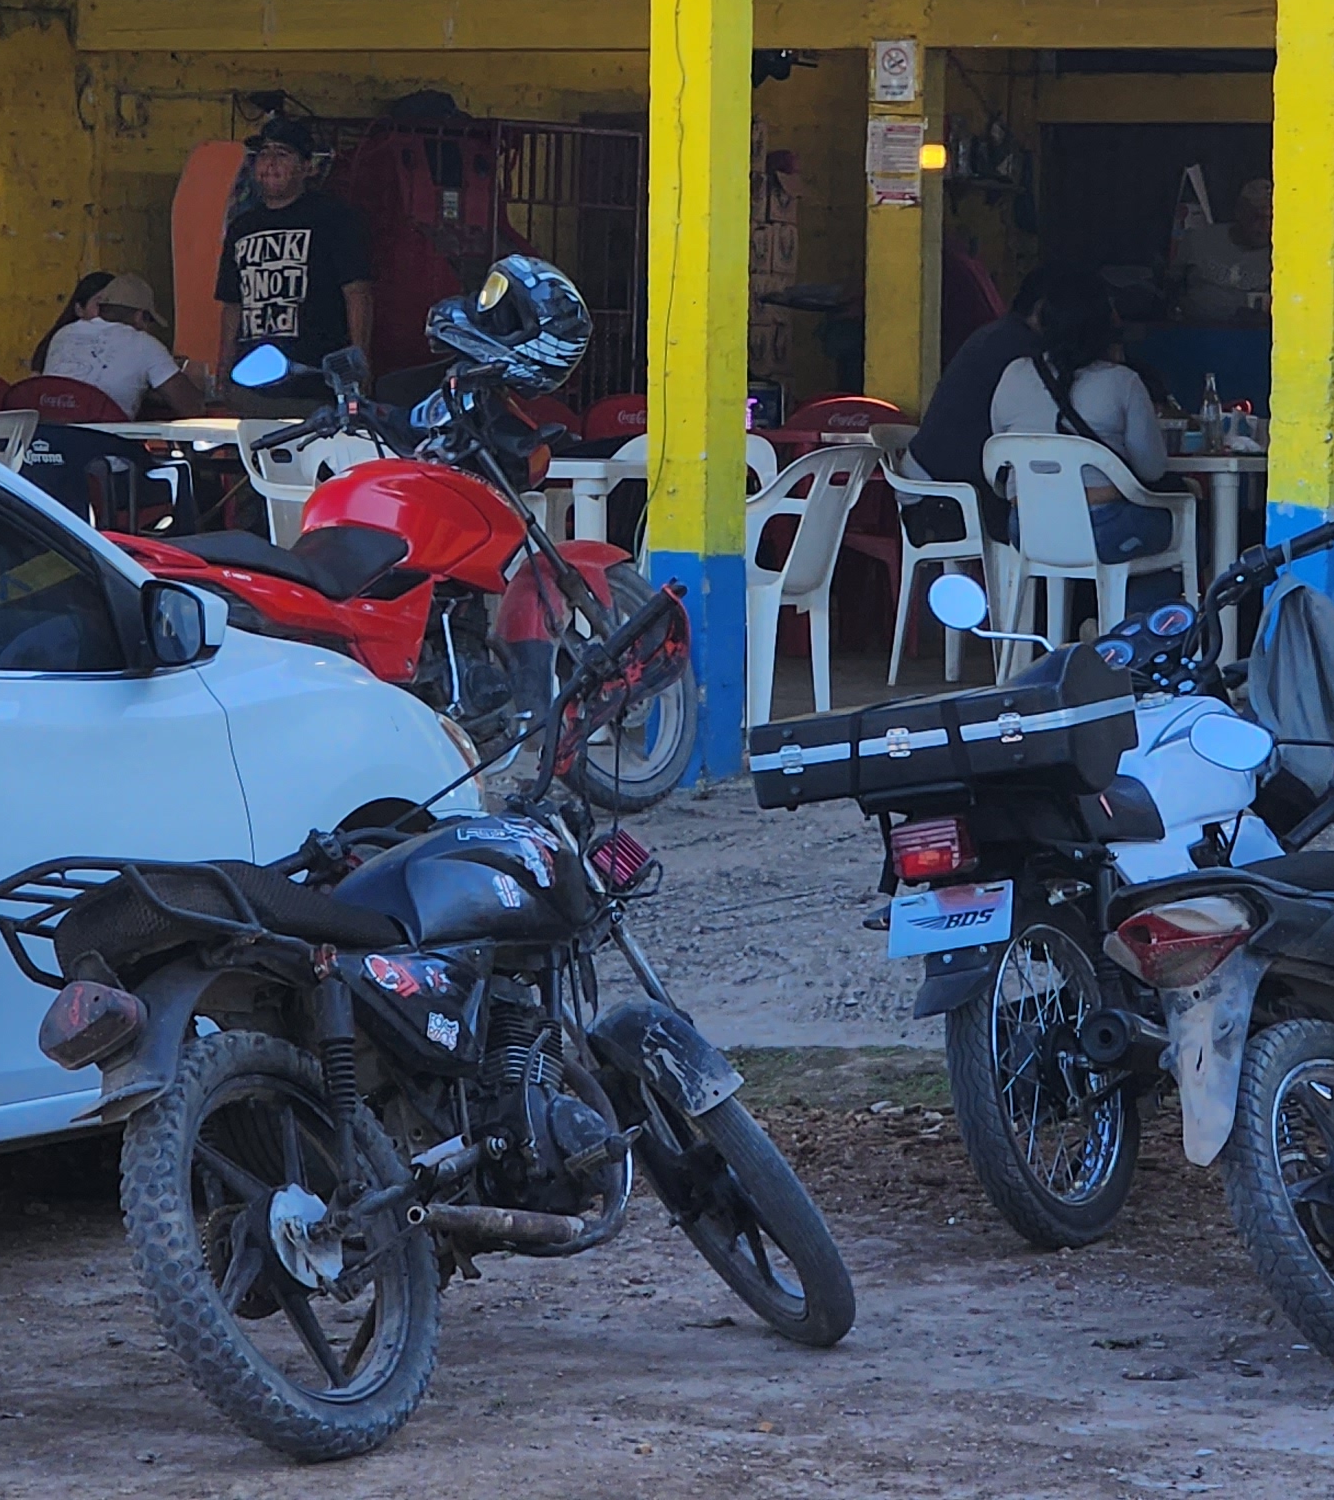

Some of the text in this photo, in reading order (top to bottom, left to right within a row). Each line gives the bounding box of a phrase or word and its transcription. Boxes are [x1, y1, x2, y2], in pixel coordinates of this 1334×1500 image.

[236, 232, 304, 265] PUNK
[254, 269, 302, 299] NOT
[945, 907, 996, 930] BDS
